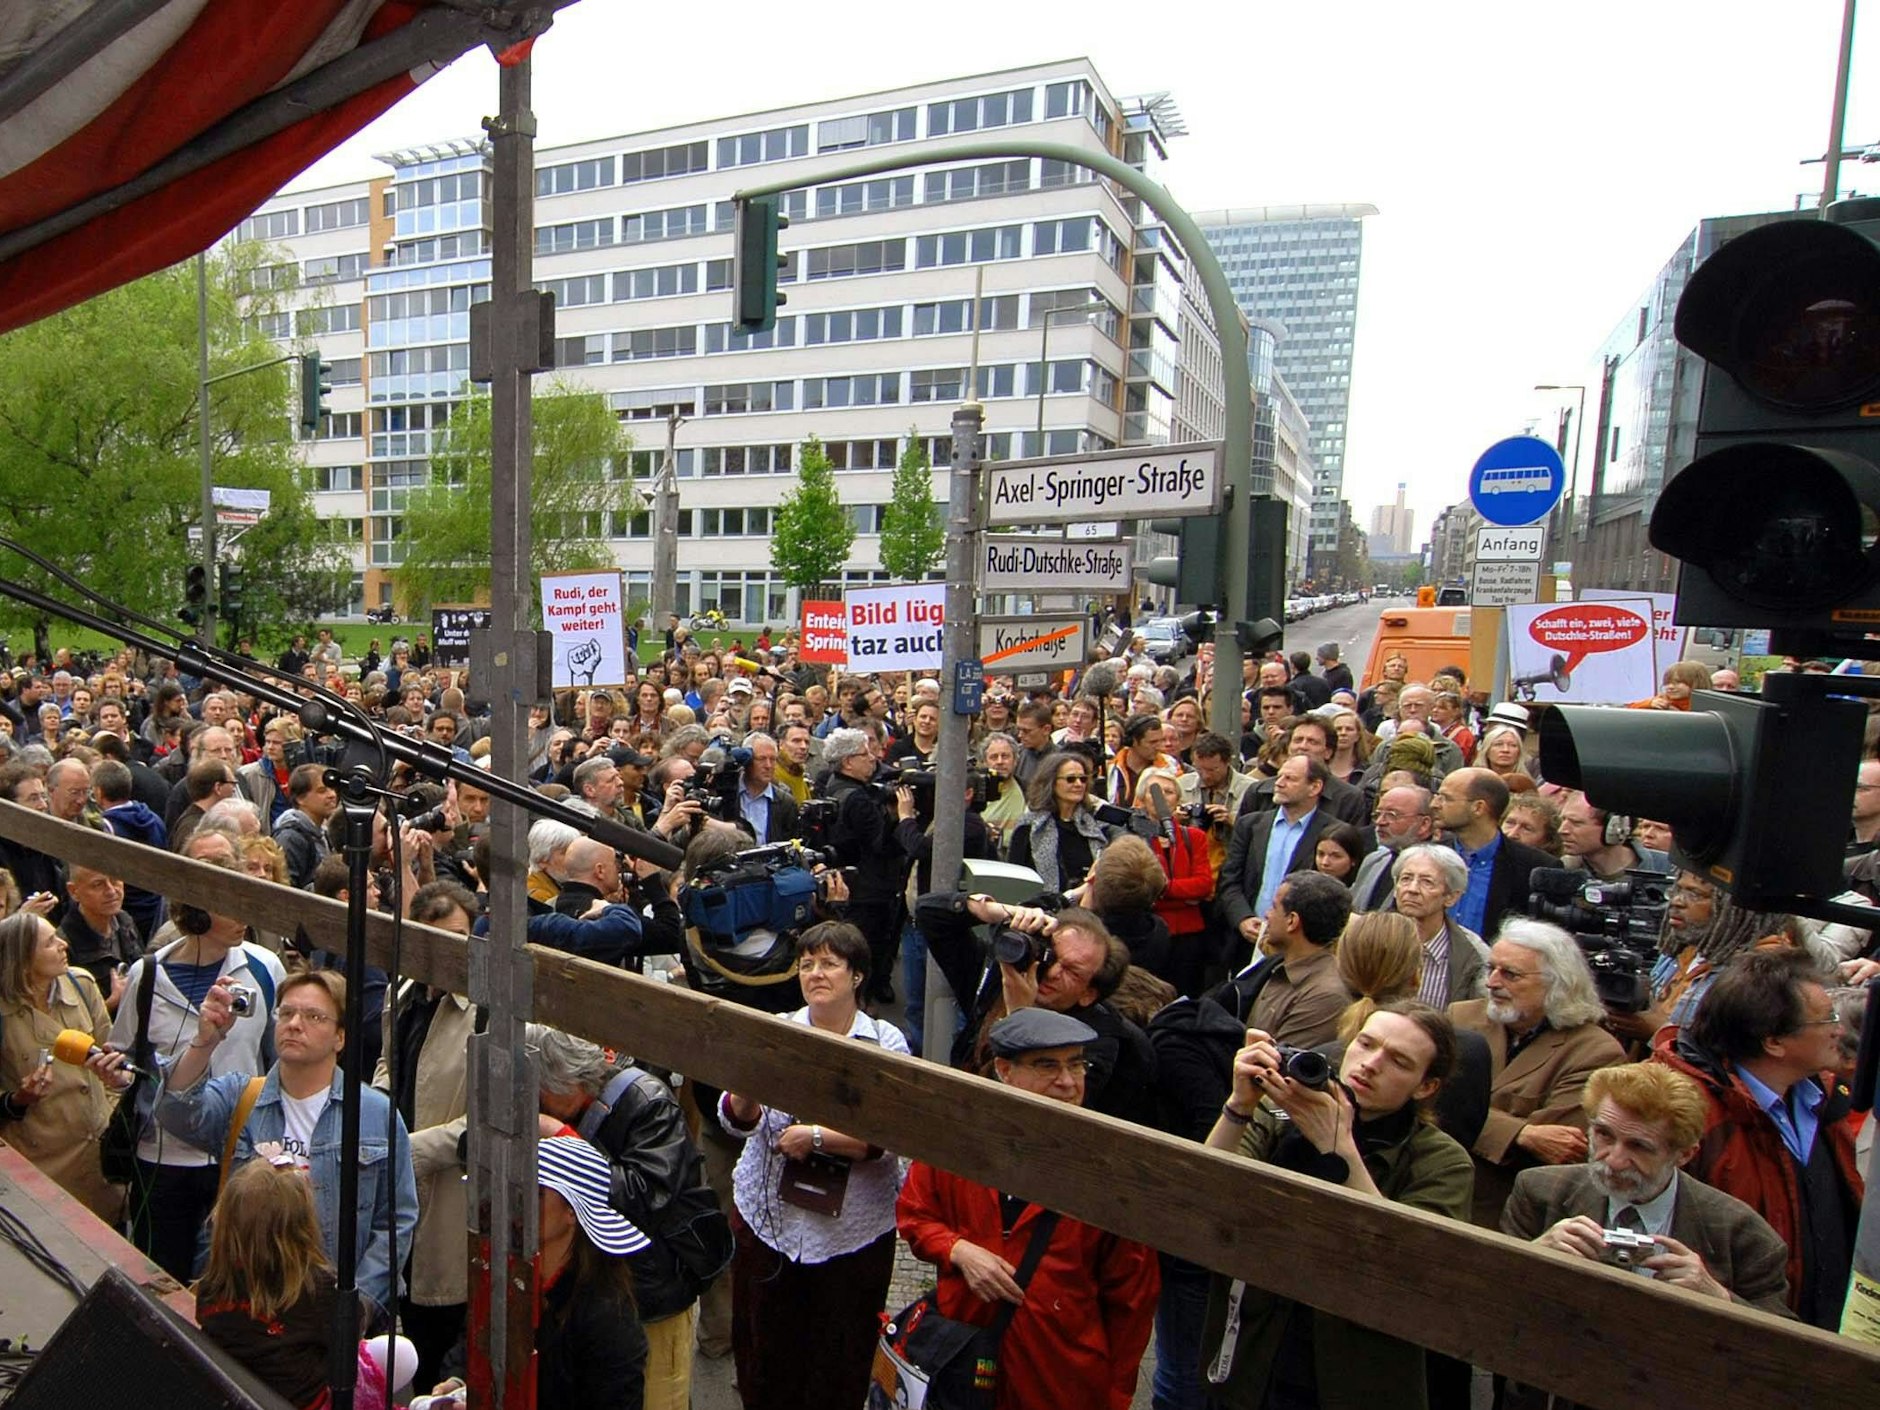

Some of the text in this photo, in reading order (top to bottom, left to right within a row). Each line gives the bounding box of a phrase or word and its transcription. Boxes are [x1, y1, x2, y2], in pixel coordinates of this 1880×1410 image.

[995, 459, 1204, 507] Axel-Springer-Straße
[1085, 525, 1097, 536] 65
[1482, 537, 1538, 554] Anfang
[987, 545, 1122, 580] Rudi-Dutschke-Straße
[554, 586, 608, 600] Rudi, der
[547, 602, 616, 617] Kampf geht
[851, 602, 897, 625] Bild
[561, 619, 604, 631] weiter!
[1535, 619, 1568, 629] Schafft
[1589, 617, 1614, 629] zwei,
[1616, 617, 1641, 627] viele
[851, 635, 888, 655] taz
